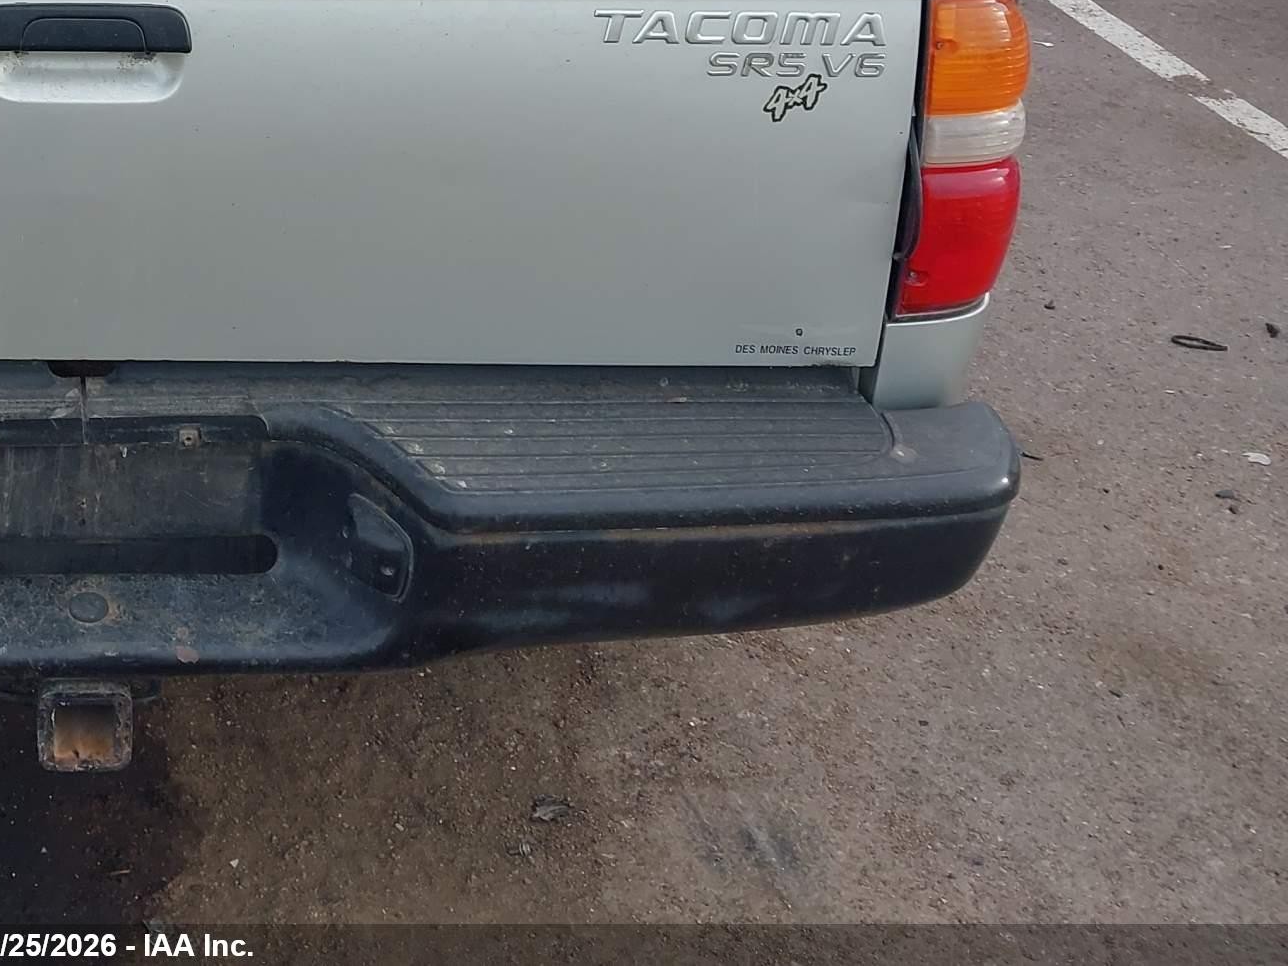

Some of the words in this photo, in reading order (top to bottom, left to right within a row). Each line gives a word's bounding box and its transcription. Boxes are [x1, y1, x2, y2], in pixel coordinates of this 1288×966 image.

[594, 9, 886, 47] TACOMA
[707, 52, 807, 77] SR5
[821, 53, 886, 77] V6
[763, 73, 827, 122] 4x4
[735, 344, 756, 354] DES
[759, 345, 799, 355] MOINES
